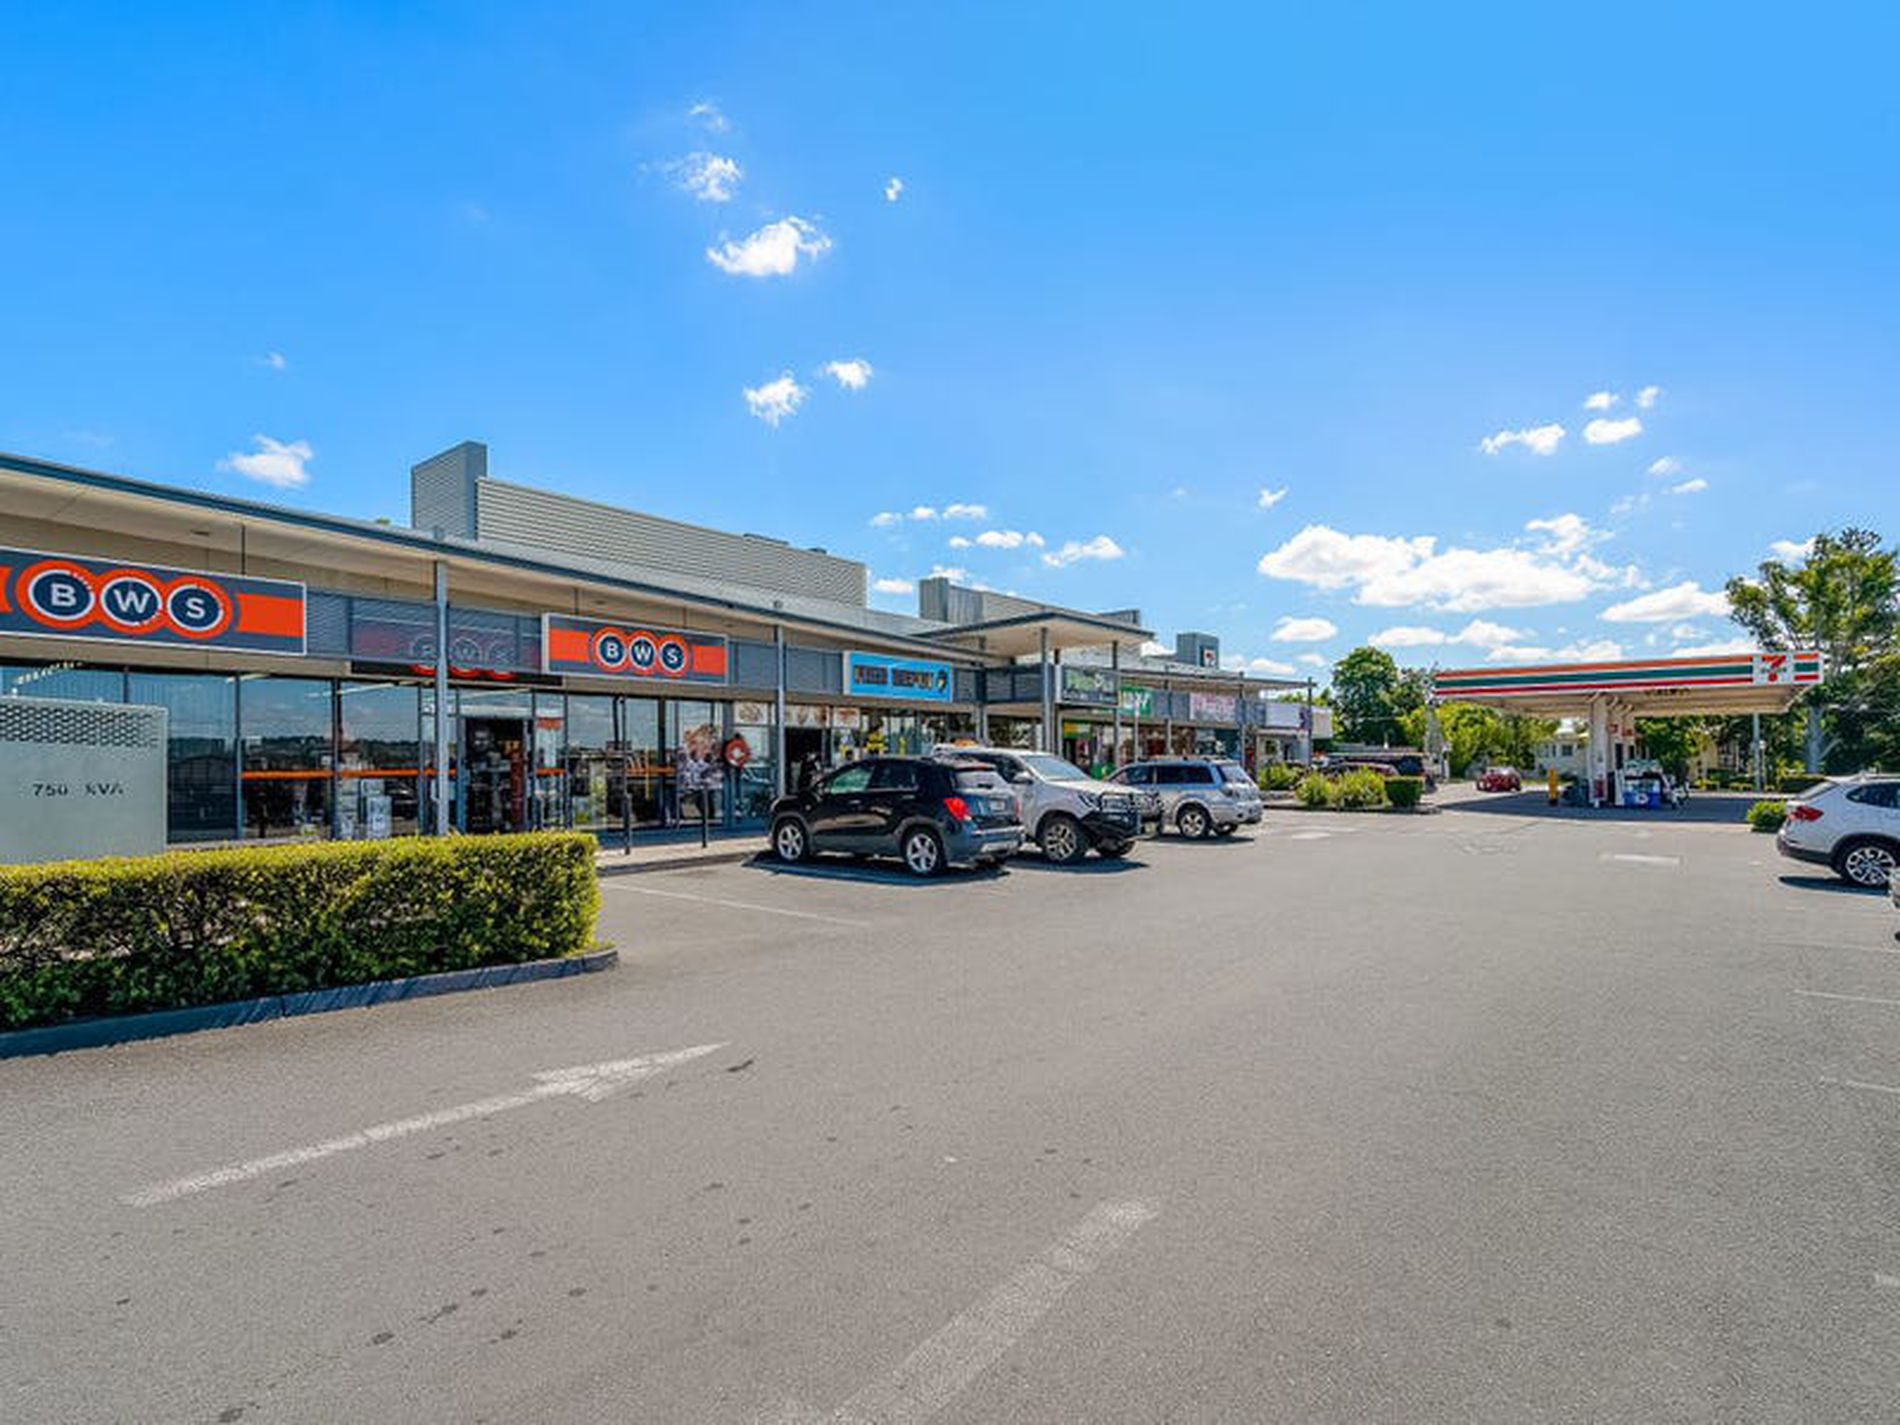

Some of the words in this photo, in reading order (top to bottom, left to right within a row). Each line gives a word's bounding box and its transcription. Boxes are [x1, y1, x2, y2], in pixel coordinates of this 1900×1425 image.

[49, 582, 206, 620] BWS
[605, 643, 679, 664] BWS
[32, 783, 68, 796] 750
